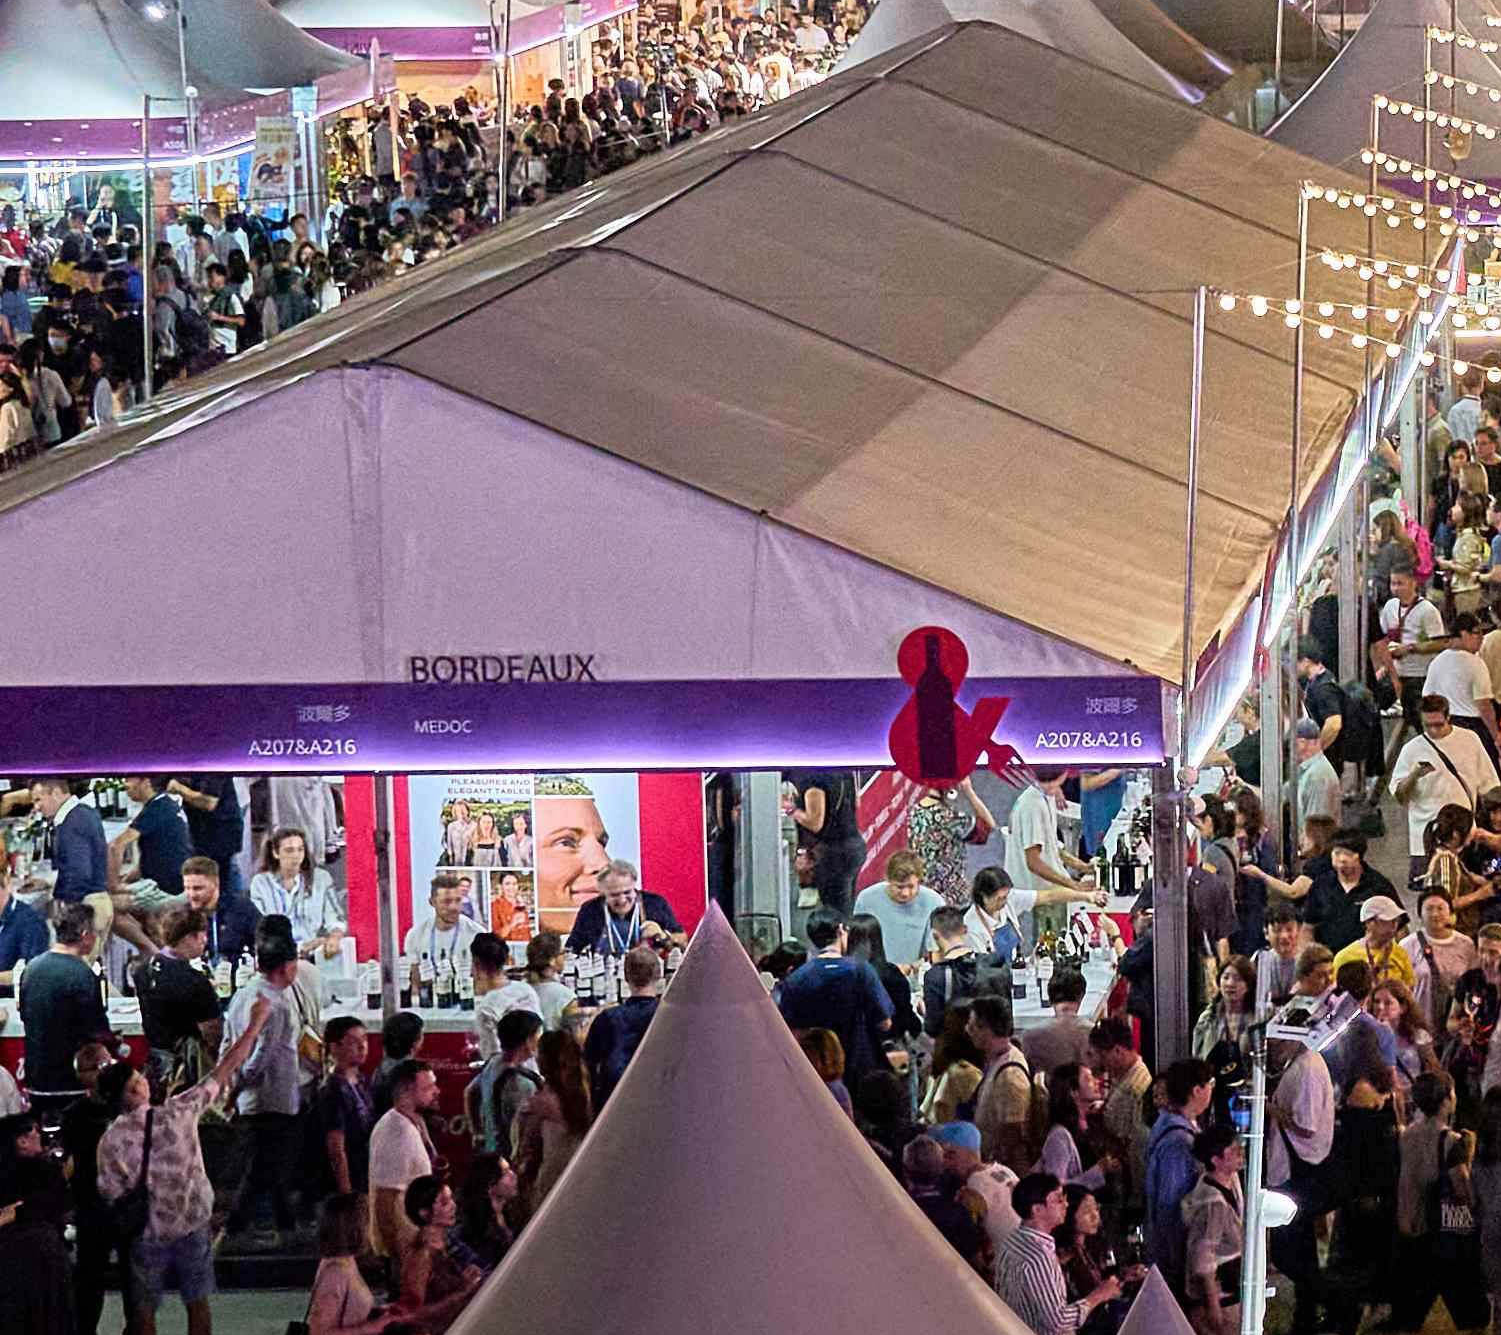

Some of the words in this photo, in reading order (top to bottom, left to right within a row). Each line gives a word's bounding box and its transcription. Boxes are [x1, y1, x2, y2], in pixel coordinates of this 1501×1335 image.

[410, 654, 599, 684] BORDEAUX
[414, 719, 473, 734] MEDOC
[247, 738, 357, 756] A207&A216
[1035, 731, 1142, 749] A207&A216
[509, 778, 531, 786] AND
